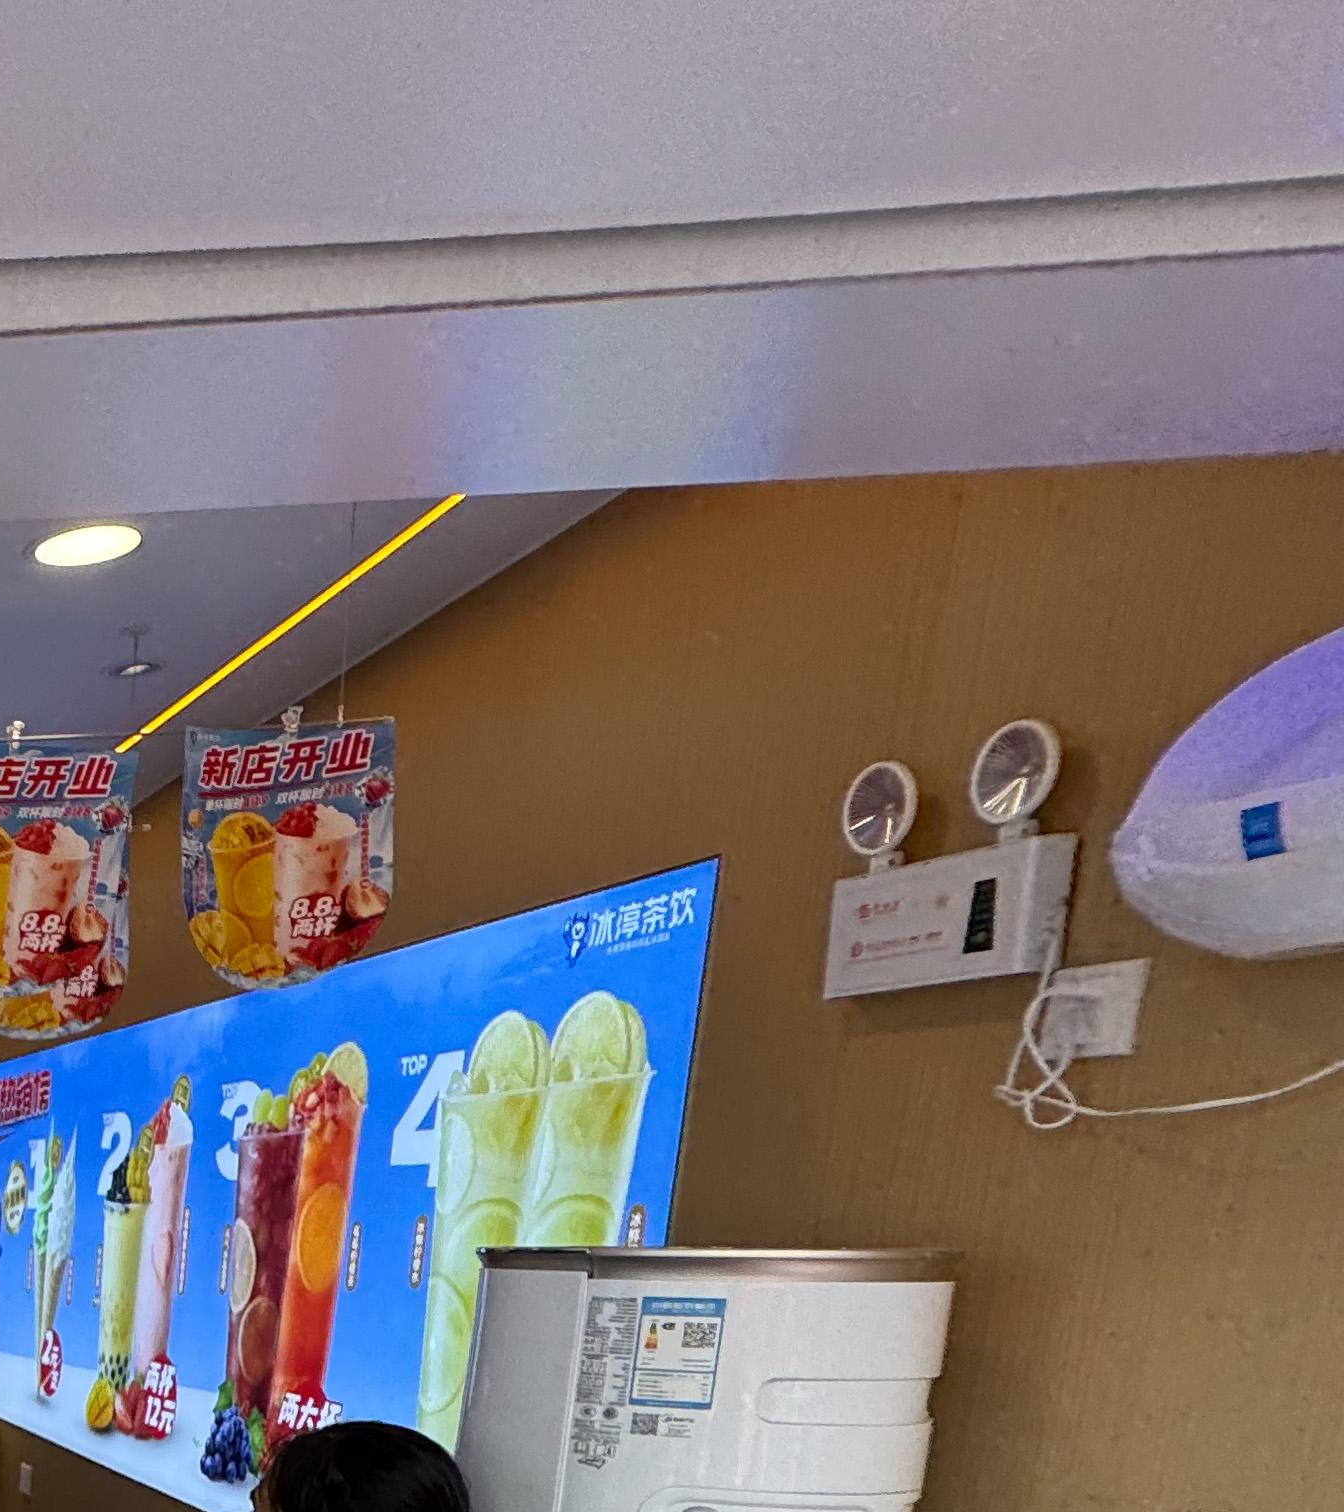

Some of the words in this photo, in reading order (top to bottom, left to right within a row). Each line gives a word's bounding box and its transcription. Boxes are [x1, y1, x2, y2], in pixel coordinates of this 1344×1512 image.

[198, 728, 376, 790] 新店开业
[291, 916, 339, 939] 两杯
[588, 886, 699, 949] 冰淳茶饮
[19, 932, 65, 953] 两杯
[401, 1054, 428, 1076] TOP
[96, 1112, 133, 1196] 2
[144, 1361, 177, 1398] 两杯
[144, 1395, 177, 1435] 12元
[276, 1392, 344, 1430] 两大杯
